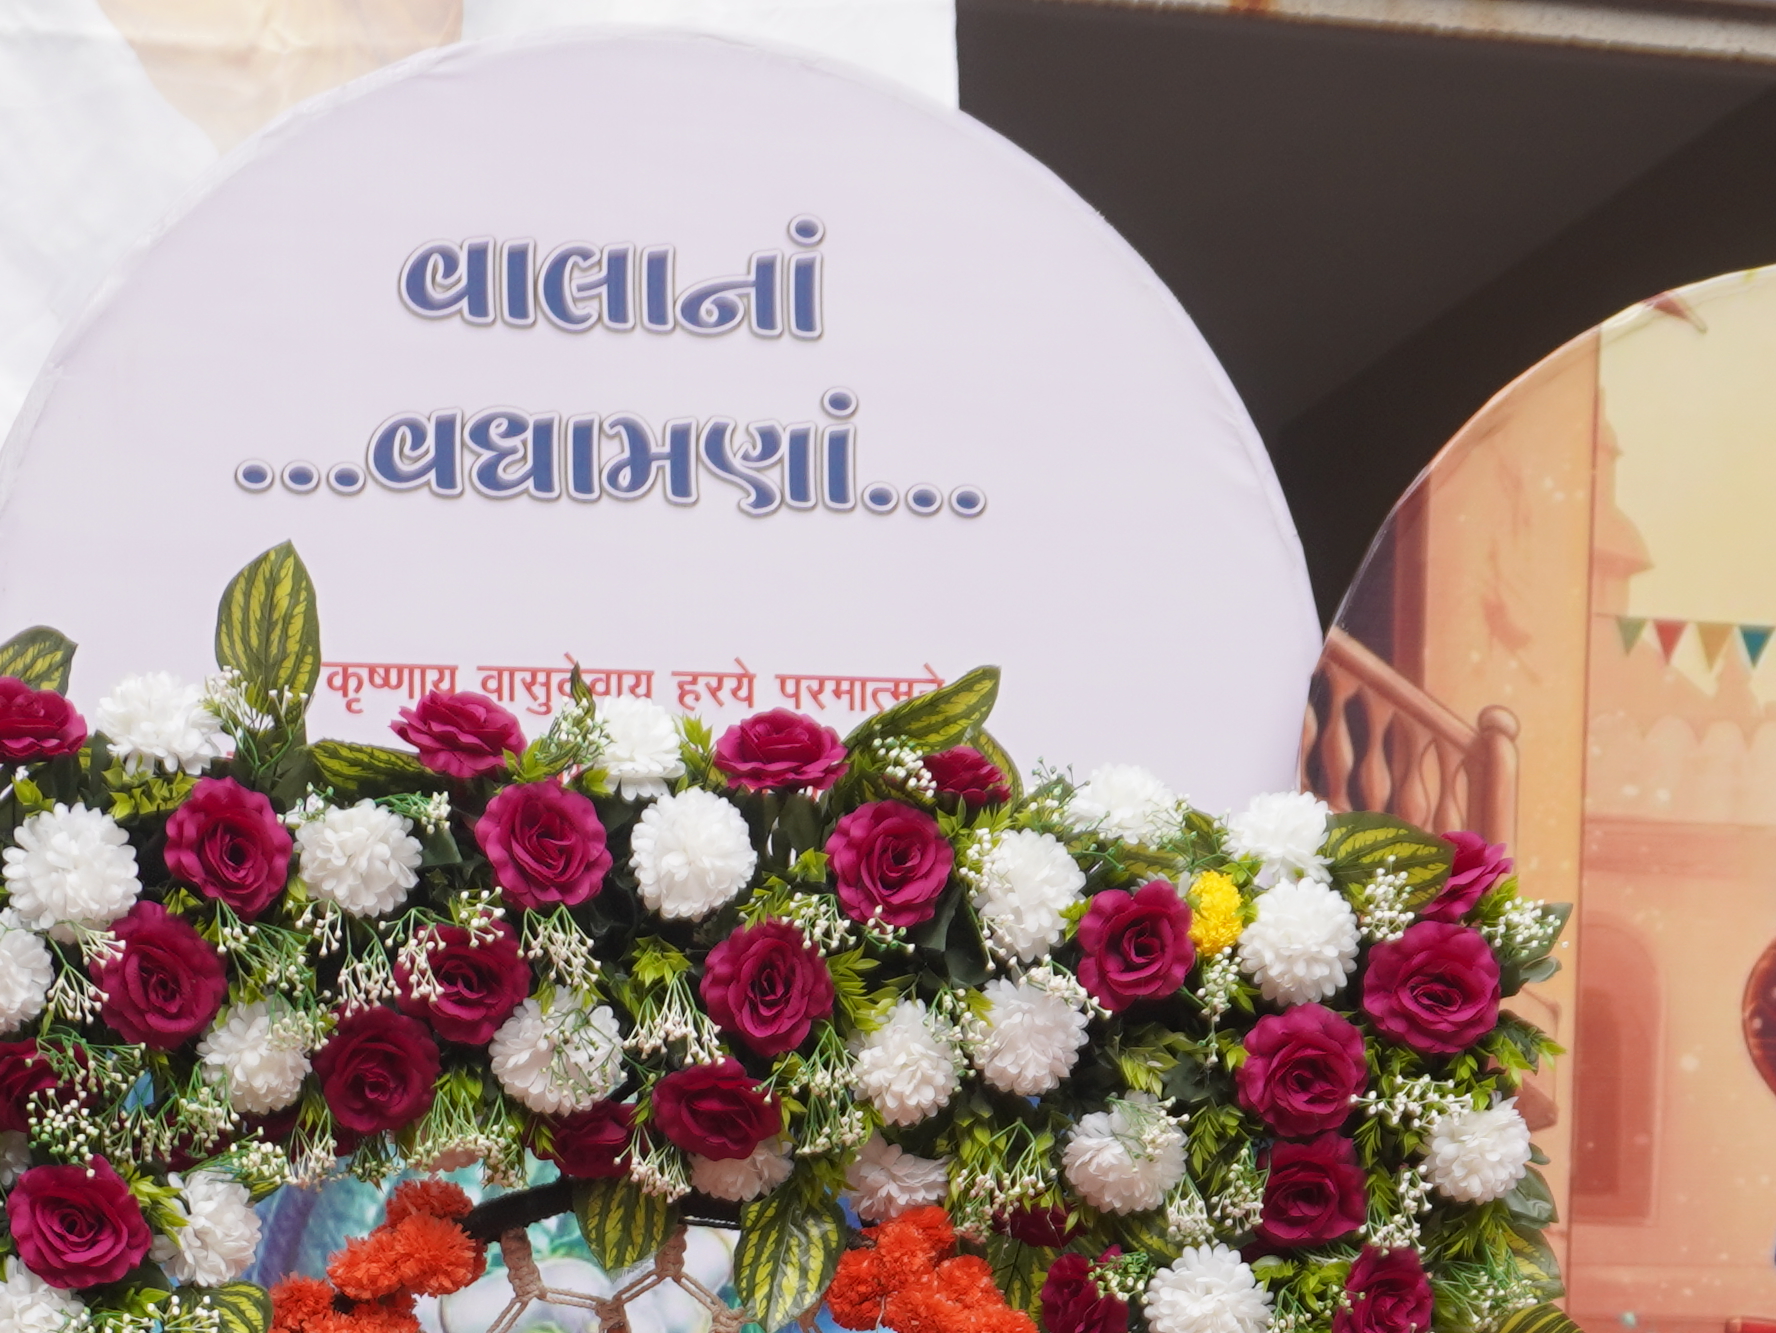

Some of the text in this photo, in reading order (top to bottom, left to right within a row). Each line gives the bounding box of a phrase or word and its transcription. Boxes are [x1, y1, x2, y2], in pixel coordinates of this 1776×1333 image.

[398, 214, 824, 340] વાલાનાં
[320, 661, 459, 714] कृष्णाय
[671, 657, 756, 712] हरये
